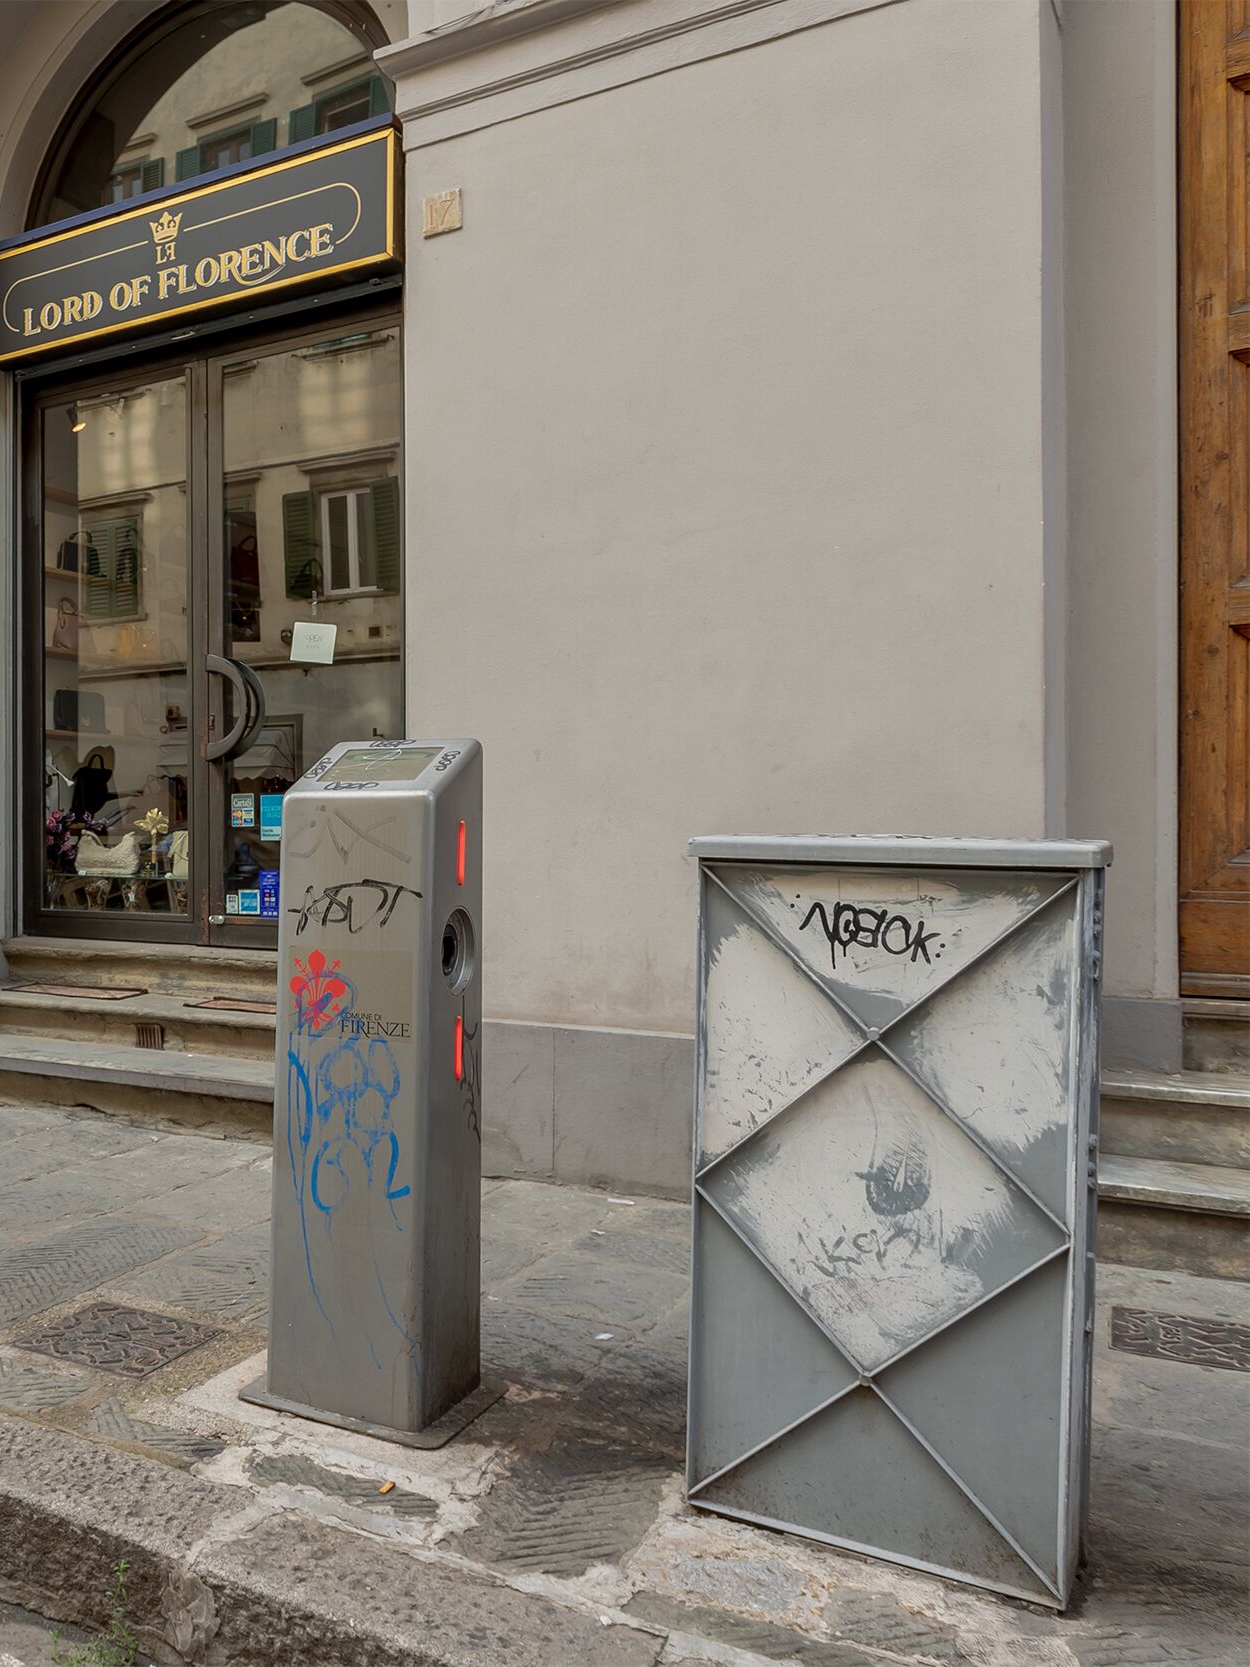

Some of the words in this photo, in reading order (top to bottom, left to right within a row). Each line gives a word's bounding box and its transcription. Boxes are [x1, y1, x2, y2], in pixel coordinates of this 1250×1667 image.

[429, 198, 455, 226] 17
[23, 290, 104, 337] LORD
[109, 274, 152, 312] OF
[157, 223, 335, 300] FLORENCE
[340, 1011, 374, 1022] COMUNE
[374, 1013, 382, 1022] DI
[340, 1019, 411, 1039] FIRENZE
